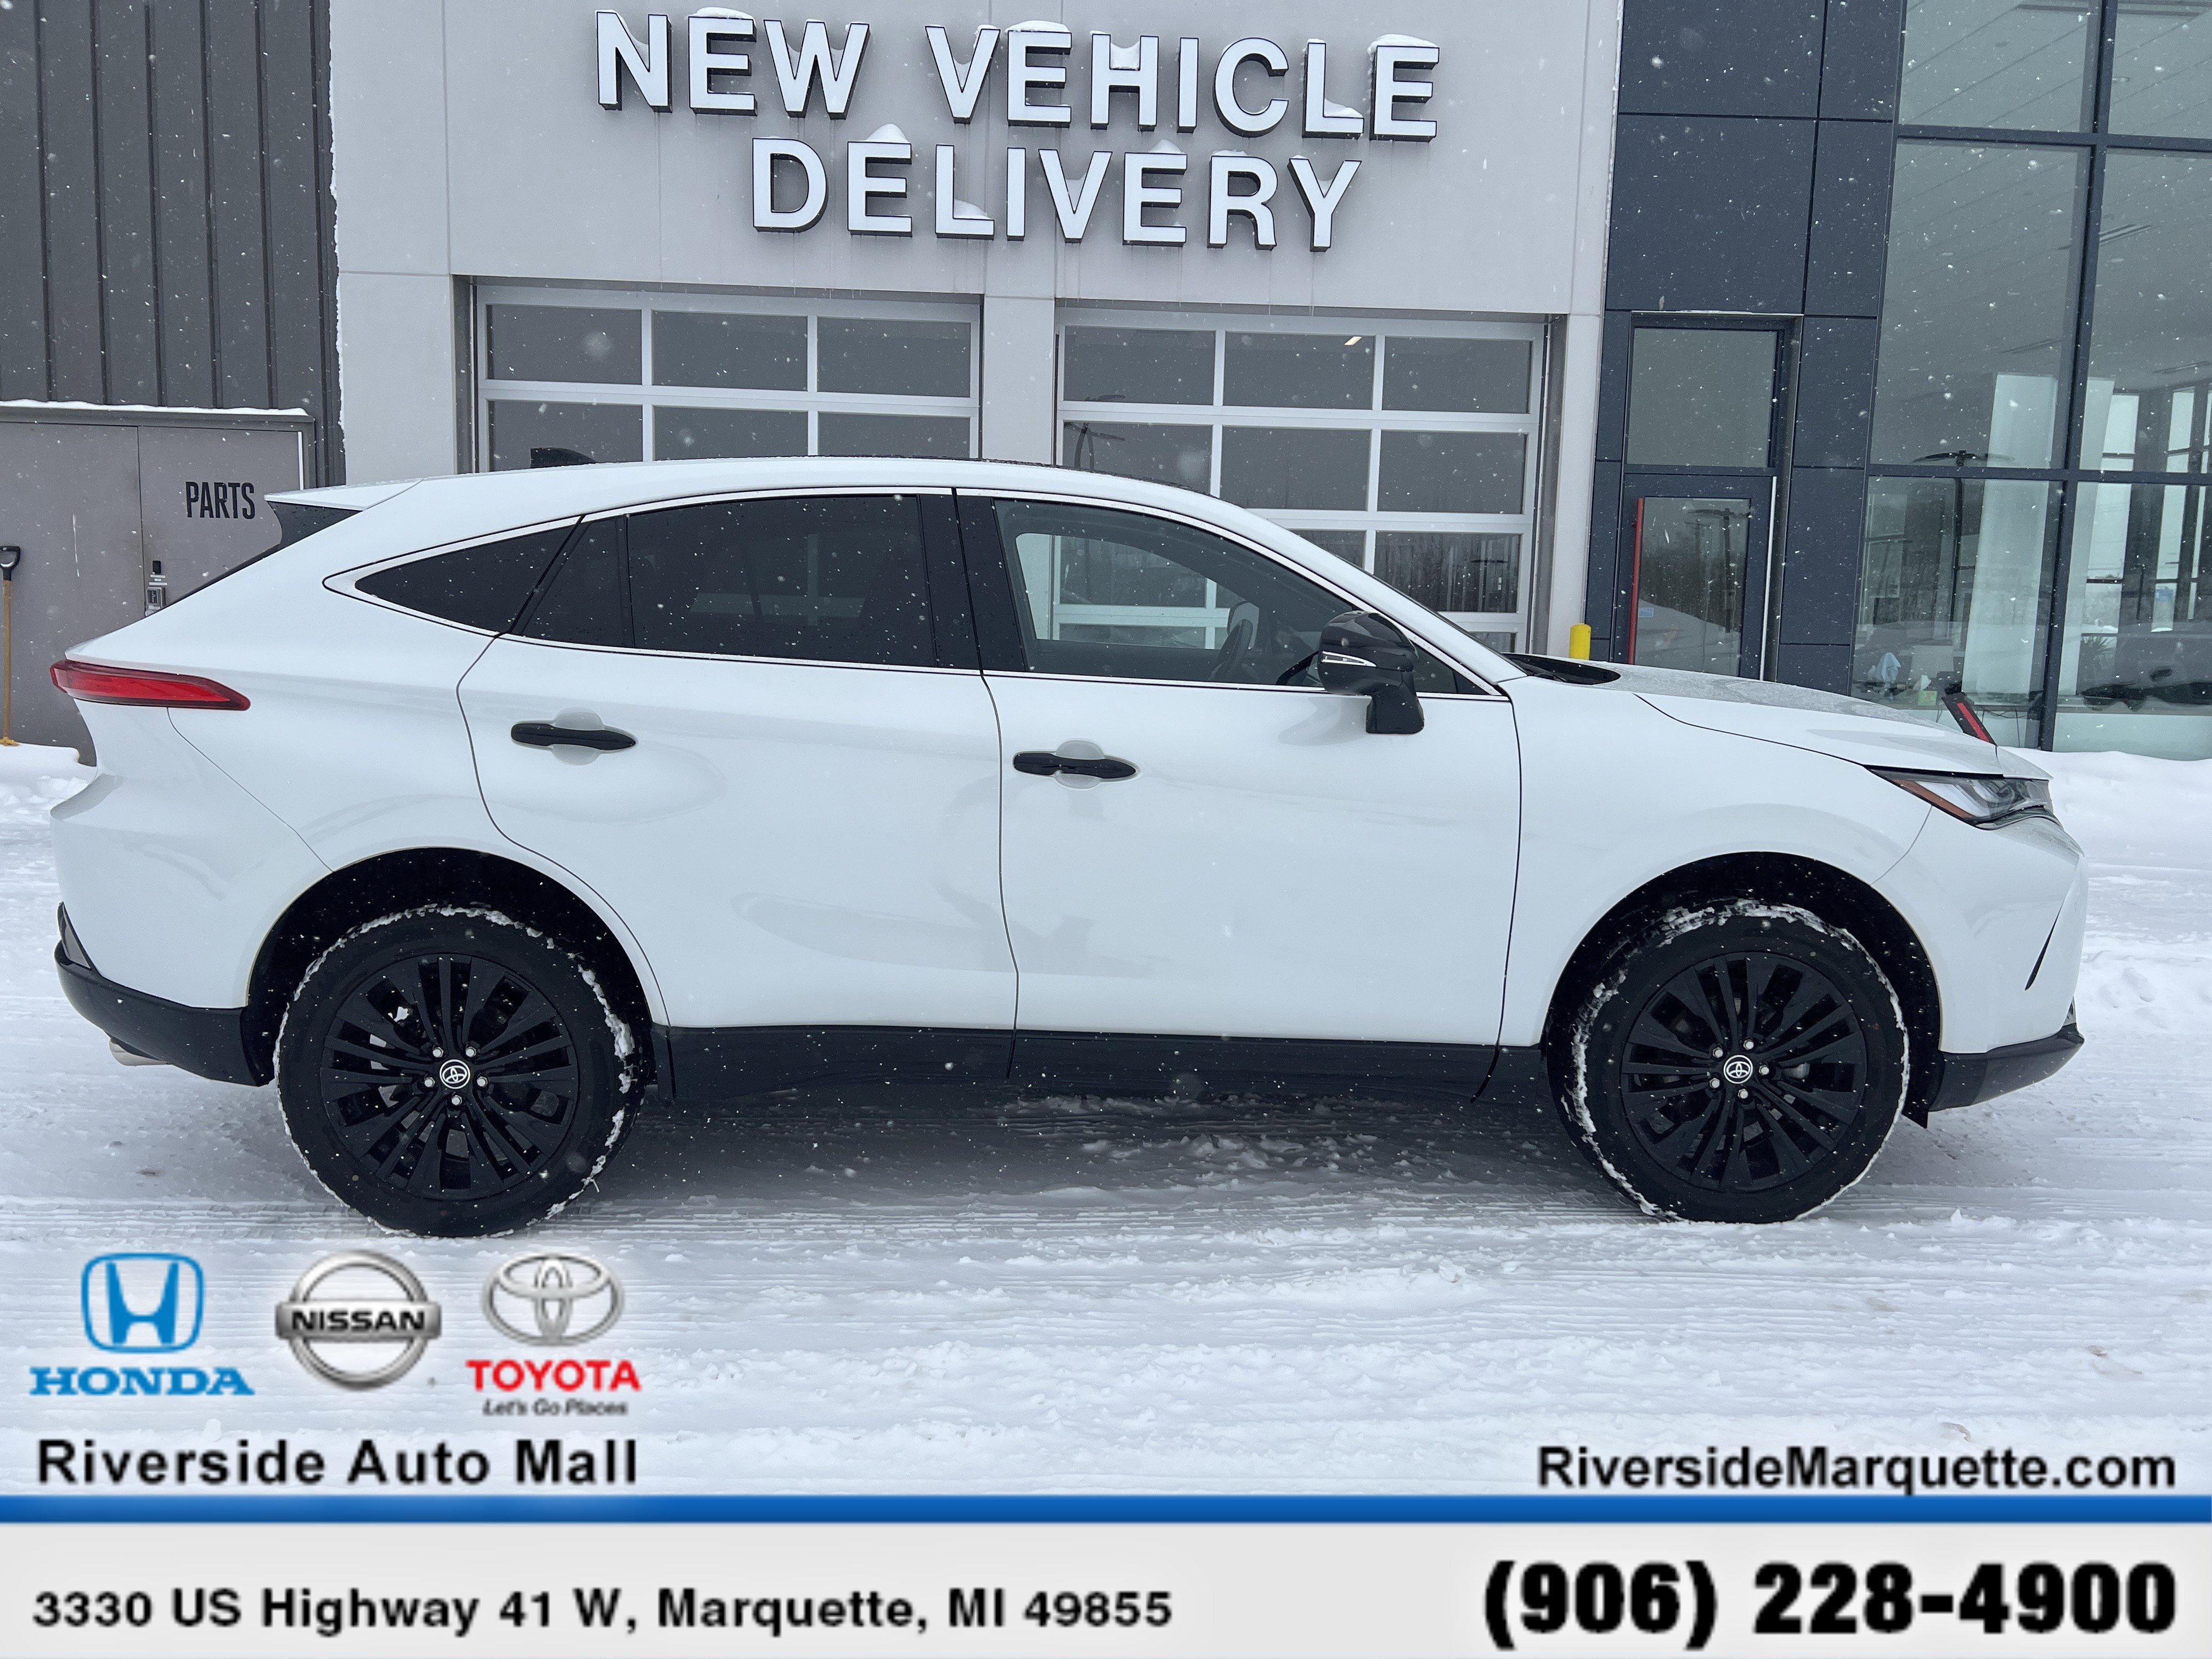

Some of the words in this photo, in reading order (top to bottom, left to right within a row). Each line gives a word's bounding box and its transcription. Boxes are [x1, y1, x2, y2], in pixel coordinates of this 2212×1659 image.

[595, 9, 870, 119] NEW
[925, 23, 1440, 143] VEHICLE
[752, 134, 1362, 252] DELIVERY
[185, 481, 256, 520] PARTS
